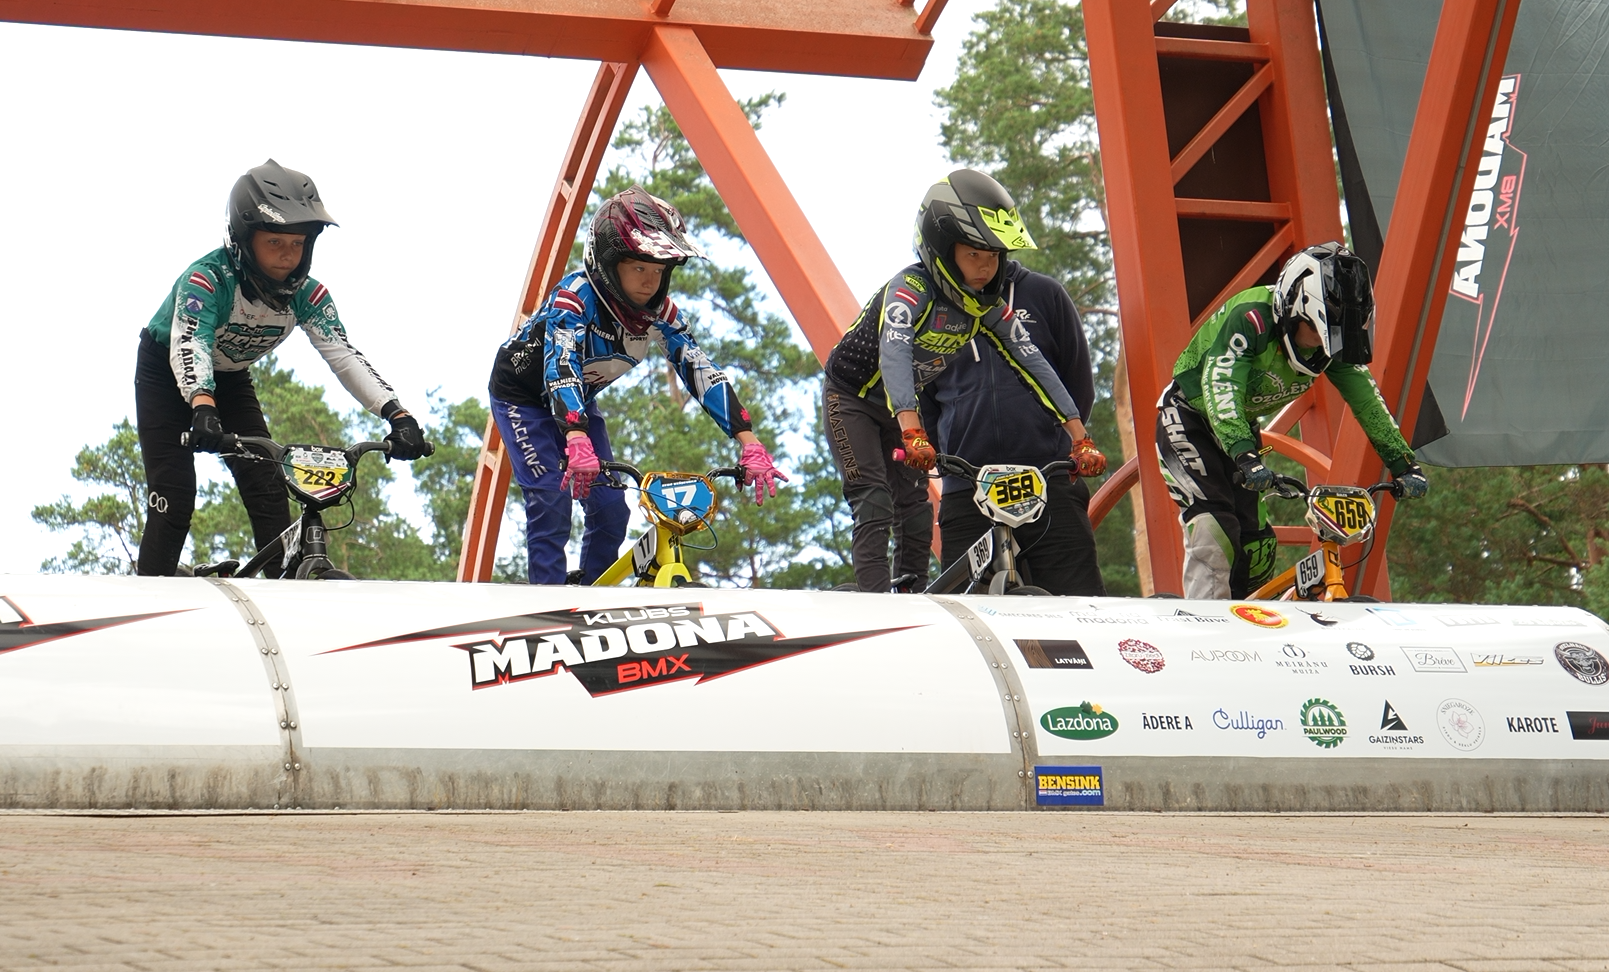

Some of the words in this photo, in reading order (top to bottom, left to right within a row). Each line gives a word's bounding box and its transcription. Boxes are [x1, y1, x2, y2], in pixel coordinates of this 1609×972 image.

[1018, 343, 1039, 358] ite
[507, 405, 547, 479] MACHINE
[826, 402, 862, 483] MACHINE
[1160, 407, 1209, 477] SHOT
[302, 469, 336, 487] 222
[995, 474, 1035, 505] 369
[661, 484, 697, 509] 17
[1334, 500, 1367, 530] 659
[638, 531, 651, 559] 17
[973, 537, 990, 568] 369
[1300, 554, 1319, 585] 659
[583, 606, 690, 626] KLUBS
[472, 612, 778, 684] MADONA
[1191, 650, 1262, 662] AUROOM
[617, 653, 692, 684] BMX
[1349, 665, 1396, 676] BURSH
[1576, 672, 1607, 685] BULLIS
[1047, 713, 1113, 731] Lazdona
[1212, 708, 1284, 739] Culligan
[1506, 717, 1559, 733] KAROTE
[1037, 775, 1101, 790] BENSINK
